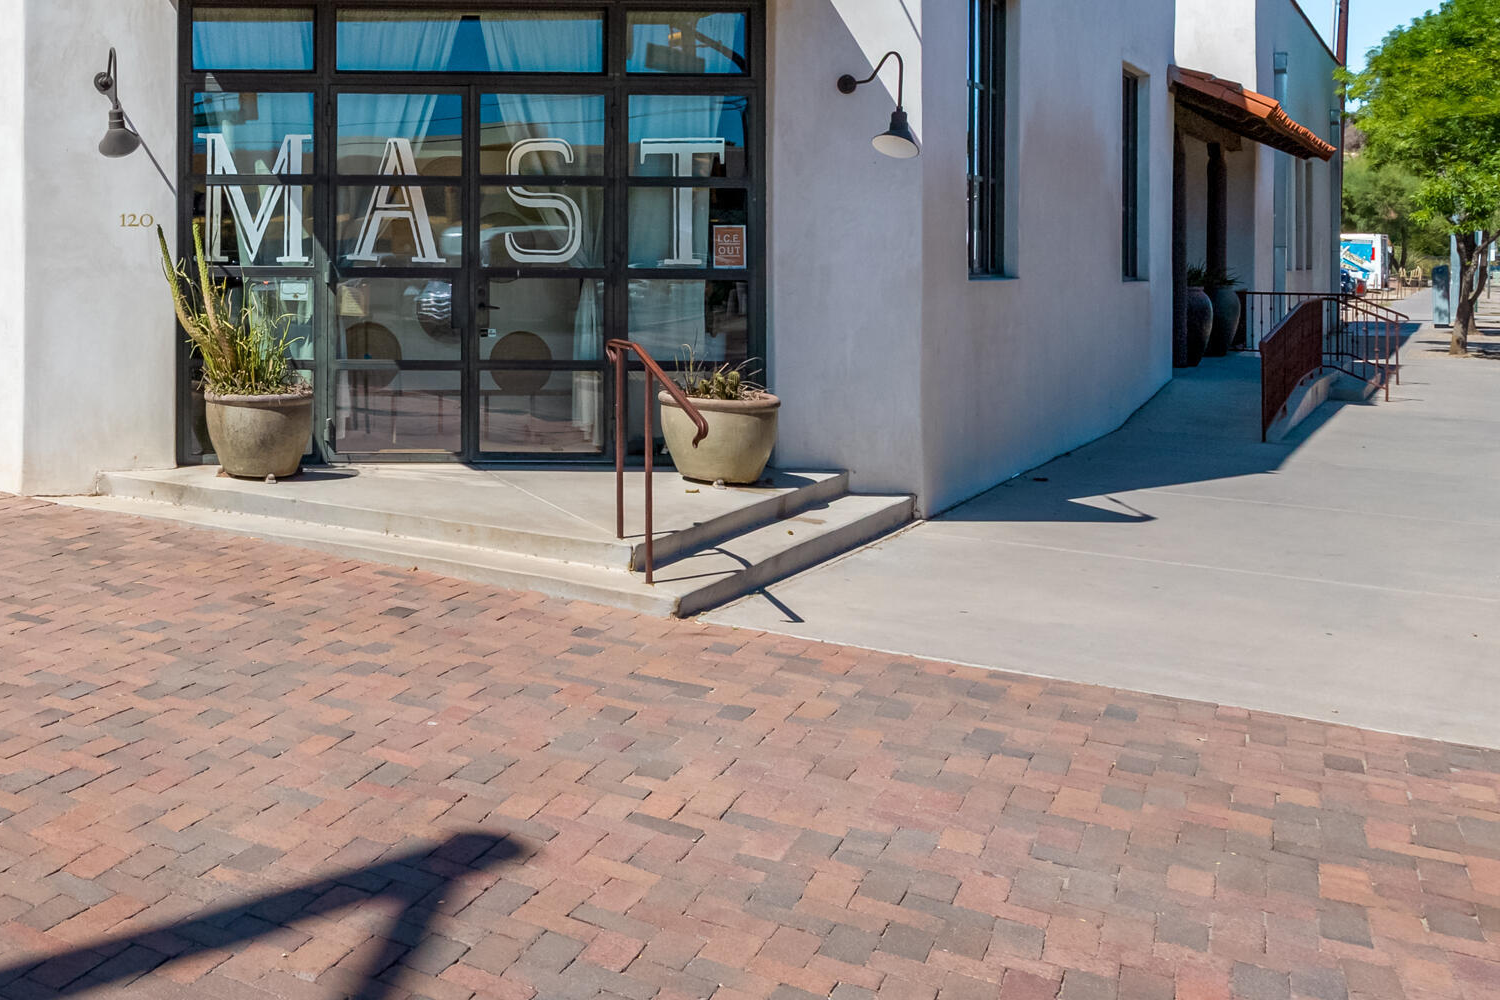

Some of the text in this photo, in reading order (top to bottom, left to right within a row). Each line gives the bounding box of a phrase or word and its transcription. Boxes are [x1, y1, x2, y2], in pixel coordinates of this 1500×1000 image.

[196, 133, 726, 267] MAST
[119, 213, 154, 228] 120
[718, 246, 741, 255] OUT
